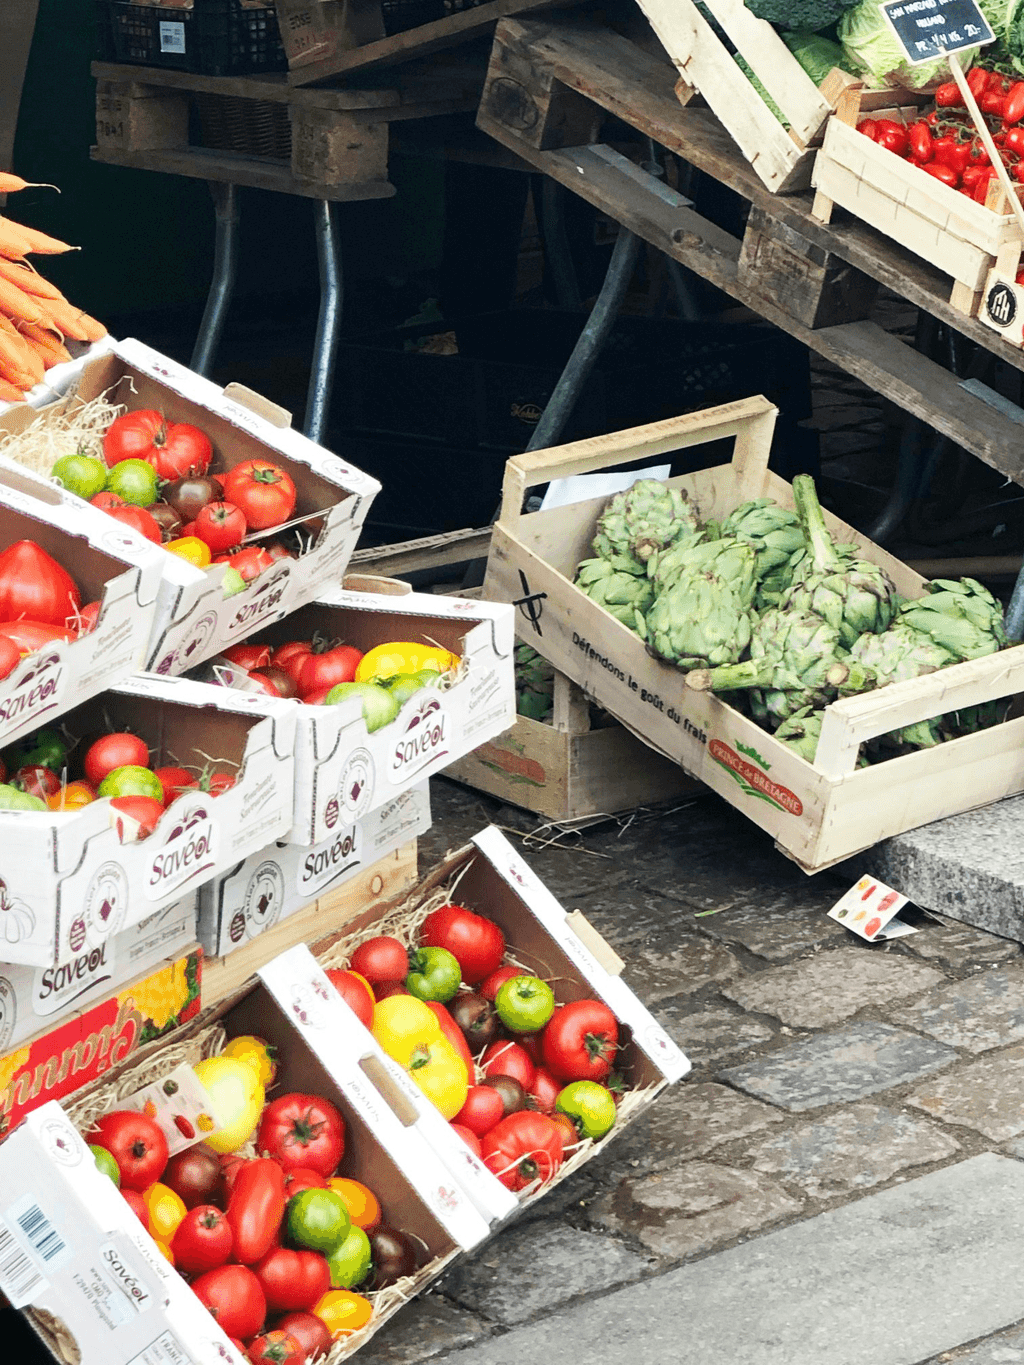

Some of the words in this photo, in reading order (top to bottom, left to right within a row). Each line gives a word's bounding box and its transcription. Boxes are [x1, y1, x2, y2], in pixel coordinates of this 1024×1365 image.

[572, 631, 625, 682] Défendons
[627, 674, 639, 692] le
[640, 688, 665, 713] goût
[666, 707, 681, 725] du
[683, 718, 708, 745] frais
[393, 714, 446, 770] Savéol
[713, 743, 744, 773] PRINCE
[753, 771, 801, 813] BRETAGNE
[150, 823, 213, 886] Savéol
[302, 824, 357, 883] Savéol
[103, 1249, 149, 1303] Savéol
